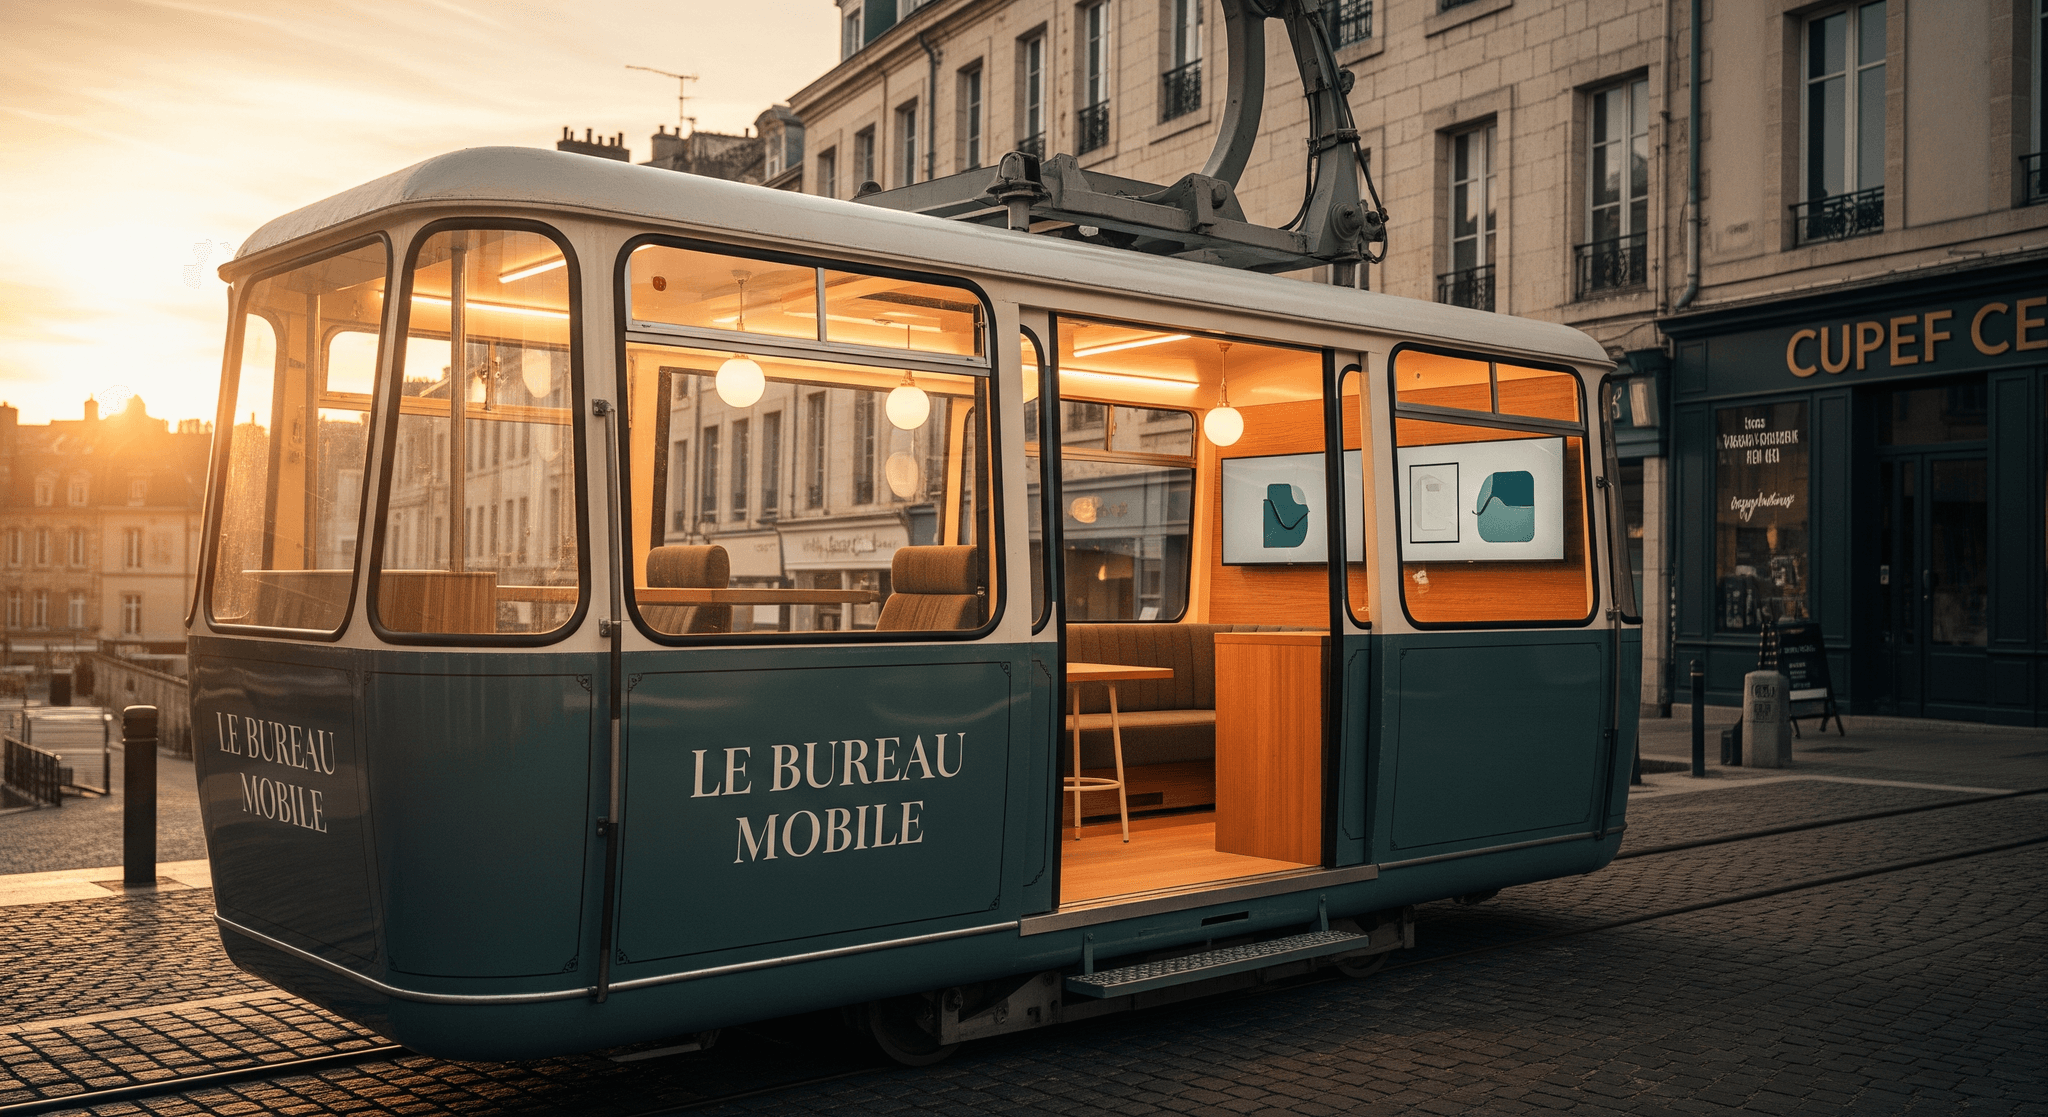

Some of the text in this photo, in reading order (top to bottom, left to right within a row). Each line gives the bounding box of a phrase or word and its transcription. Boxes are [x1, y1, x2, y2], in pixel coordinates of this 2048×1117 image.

[1786, 296, 2048, 378] CUPEF CE
[216, 711, 335, 775] LE BUREAU
[690, 732, 966, 798] LE BUREAU
[240, 772, 327, 833] MOBILE
[733, 800, 924, 864] MOBILE
